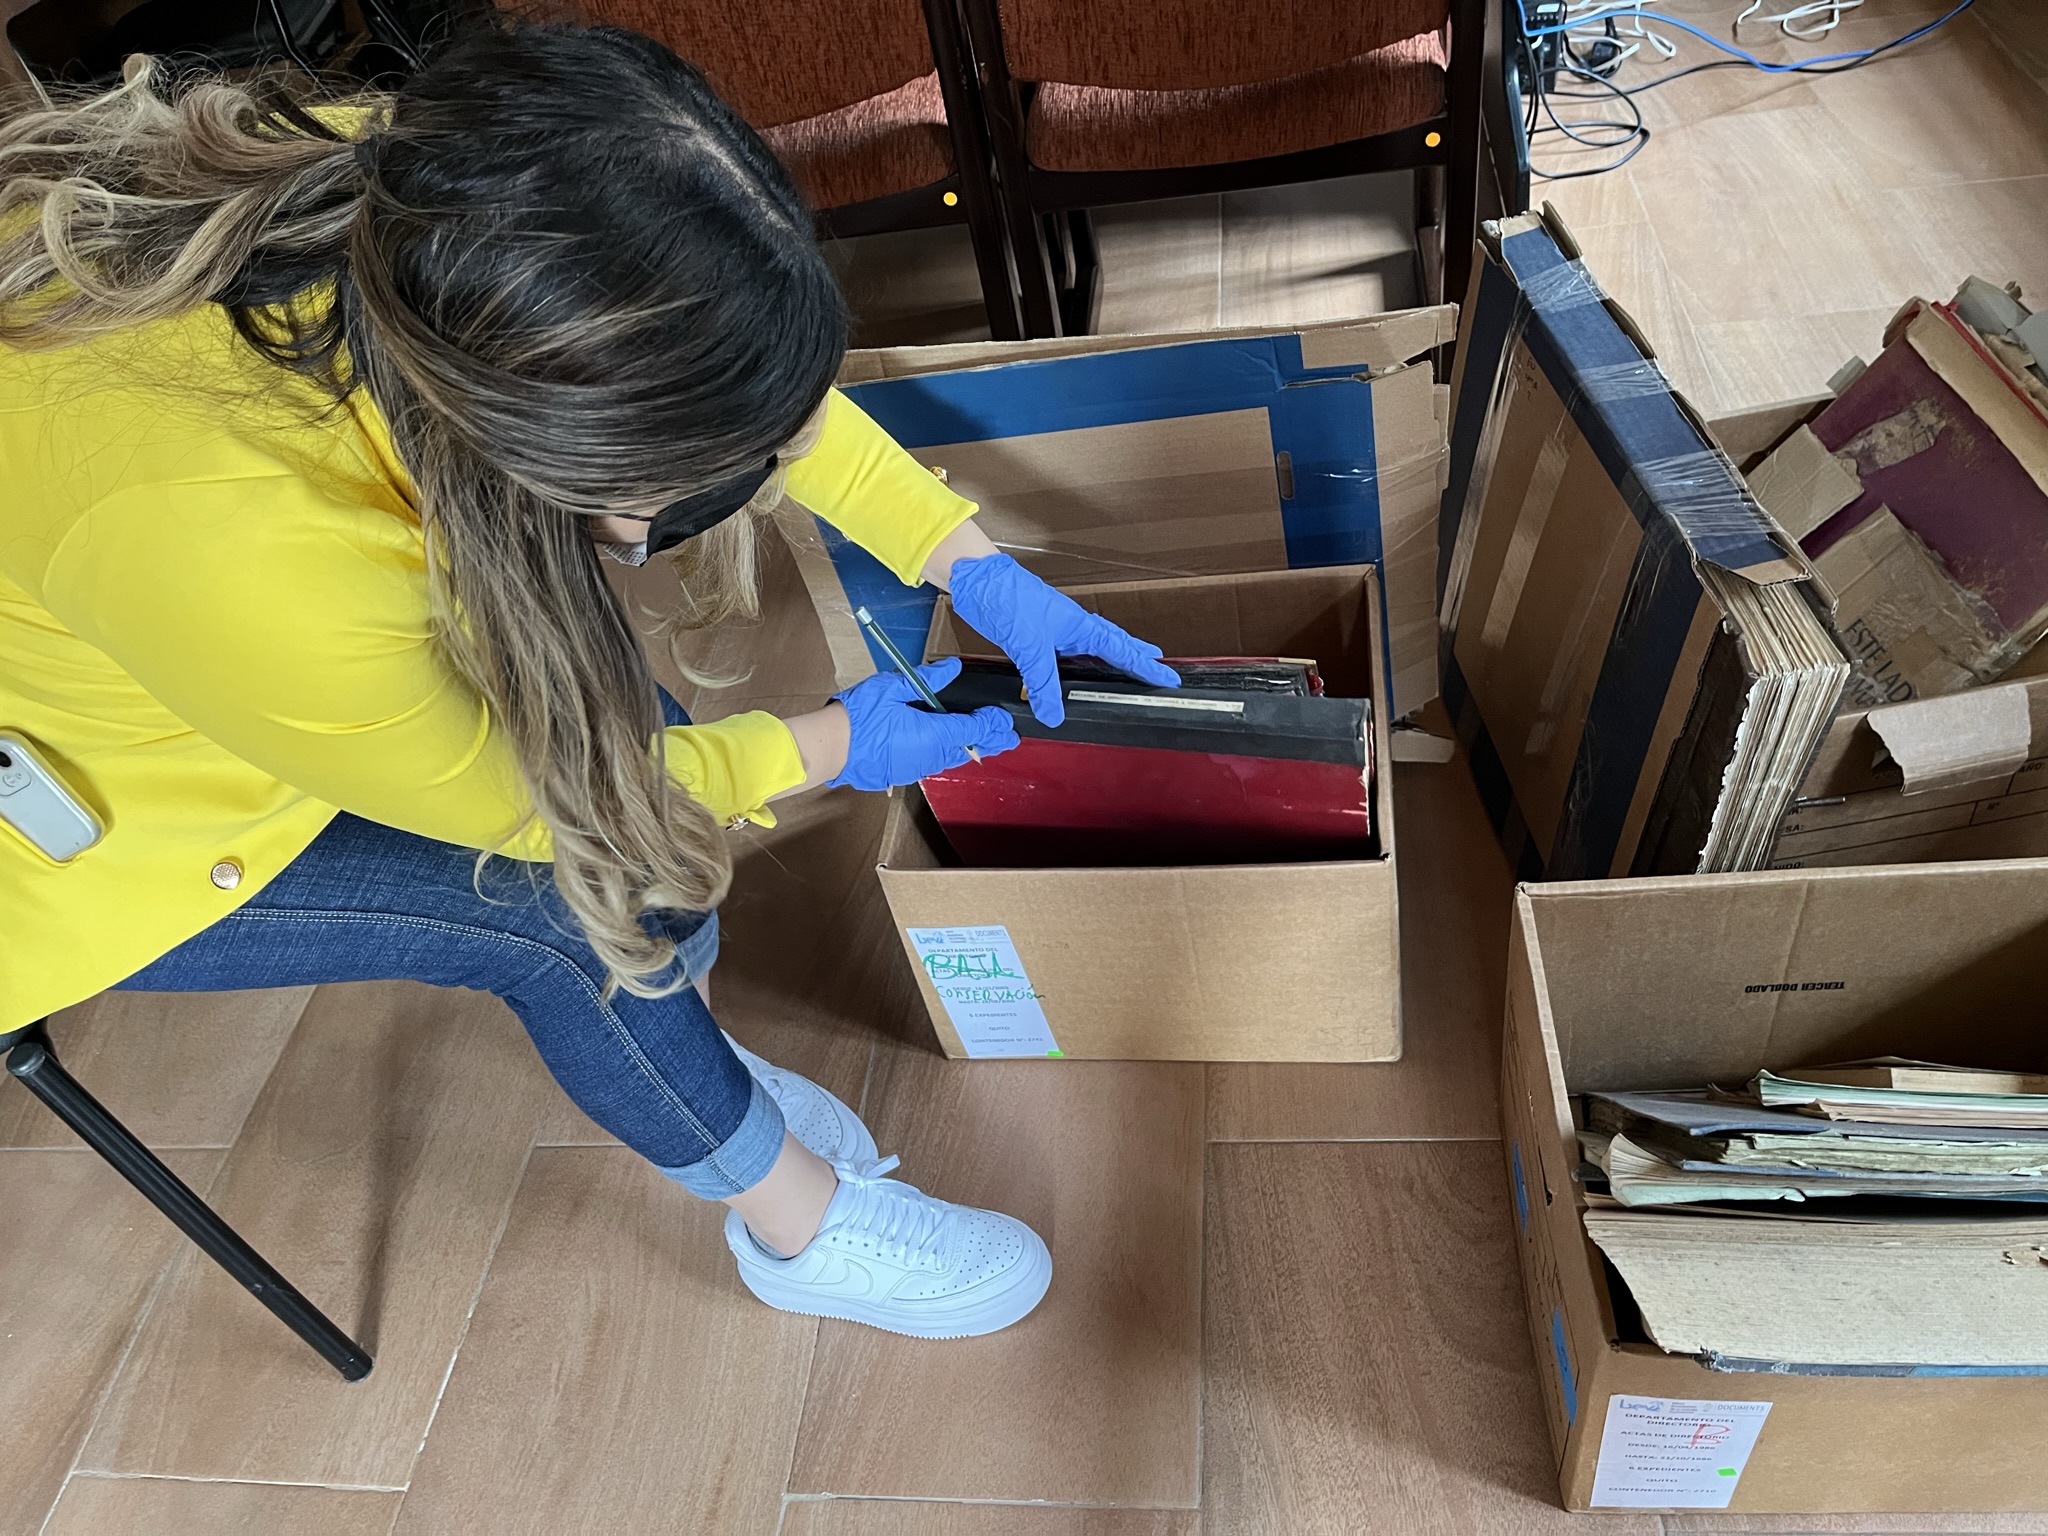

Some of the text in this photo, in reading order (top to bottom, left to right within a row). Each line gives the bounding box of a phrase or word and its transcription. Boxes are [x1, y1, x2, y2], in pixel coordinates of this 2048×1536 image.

[1844, 618, 1886, 668] ESTE
[922, 951, 1025, 980] BAJA
[1744, 981, 1845, 994] TERCER DOBLADO
[1717, 1403, 1765, 1412] DOCUMENTS
[1625, 1413, 1714, 1423] DEPARTAMENTO
